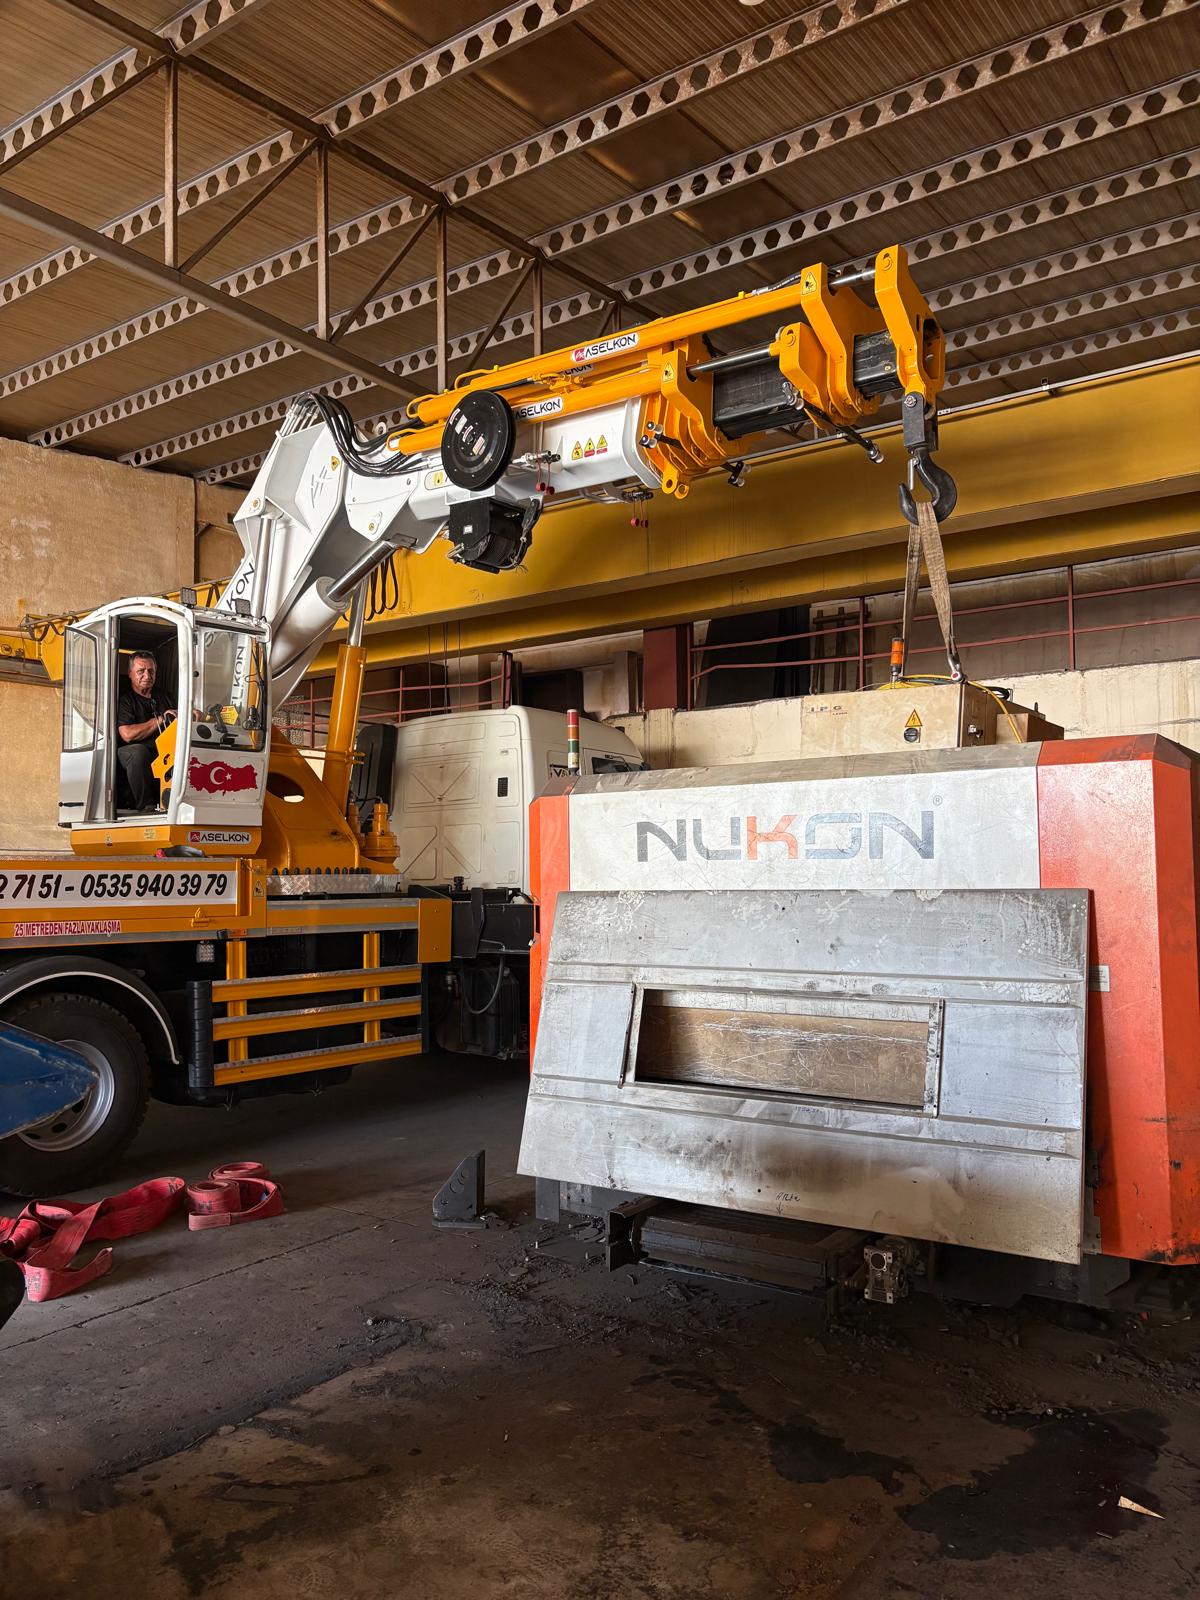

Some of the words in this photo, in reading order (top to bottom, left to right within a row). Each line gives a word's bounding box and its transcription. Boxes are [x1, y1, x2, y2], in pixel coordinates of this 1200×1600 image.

[585, 334, 636, 358] ASELKON
[200, 833, 250, 843] ASELKON
[636, 810, 935, 862] NUKON
[11, 874, 36, 899] 71
[38, 874, 62, 898] 51
[80, 873, 133, 898] 0535
[135, 873, 174, 897] 940
[177, 873, 201, 897] 39
[204, 873, 228, 896] 79
[15, 924, 24, 936] 25
[26, 923, 63, 936] METREDEN
[64, 922, 85, 934] FAZLA
[87, 921, 121, 935] YAKLAŞMA
